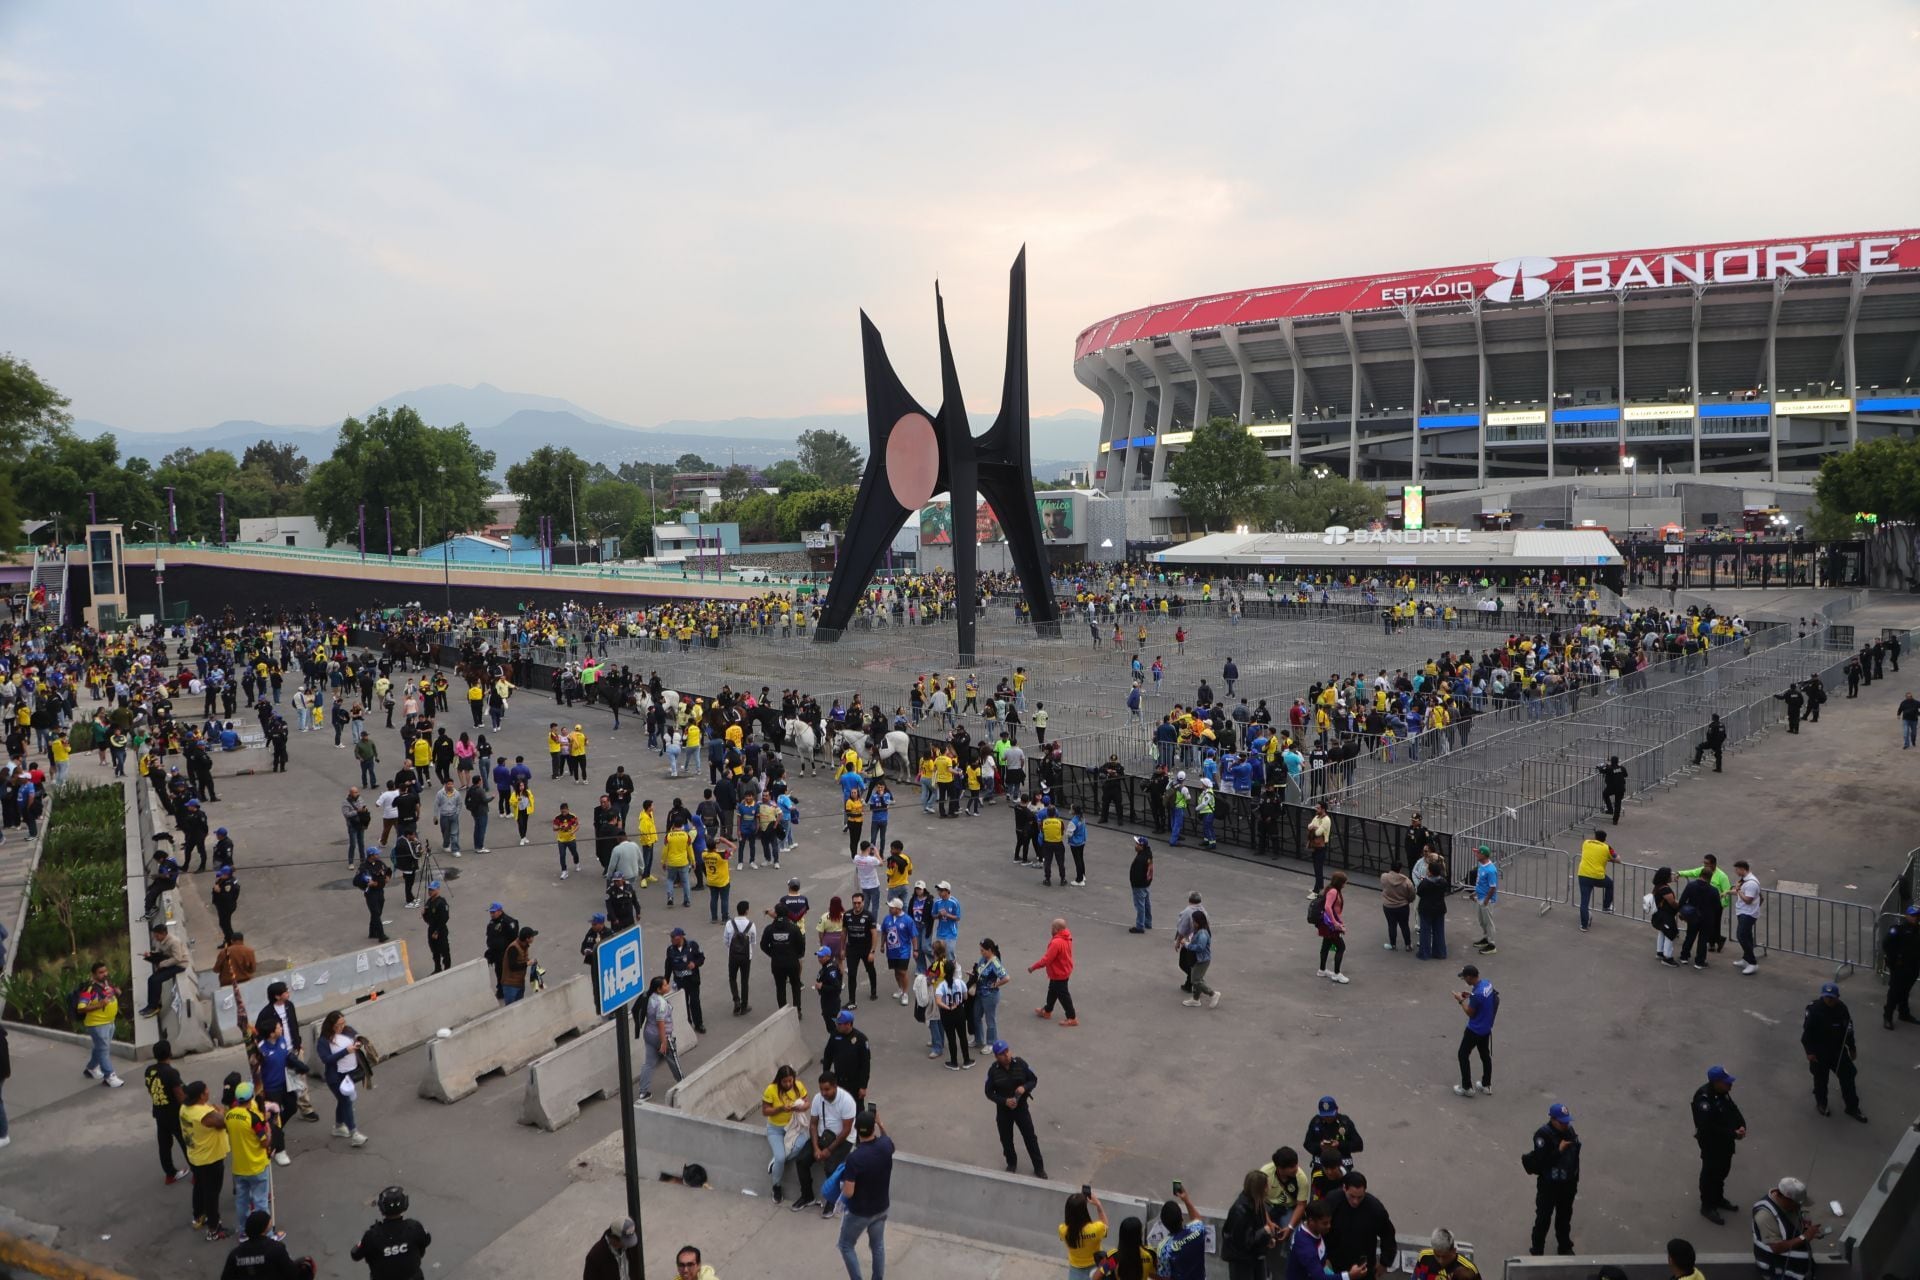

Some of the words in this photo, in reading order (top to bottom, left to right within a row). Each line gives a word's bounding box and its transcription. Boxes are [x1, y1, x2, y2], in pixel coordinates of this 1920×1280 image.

[1382, 281, 1472, 301] ESTADIO
[1573, 237, 1901, 294] BANORTE
[1354, 528, 1471, 544] BANORTE
[383, 1242, 409, 1257] SSC
[1171, 1229, 1201, 1251] Corona
